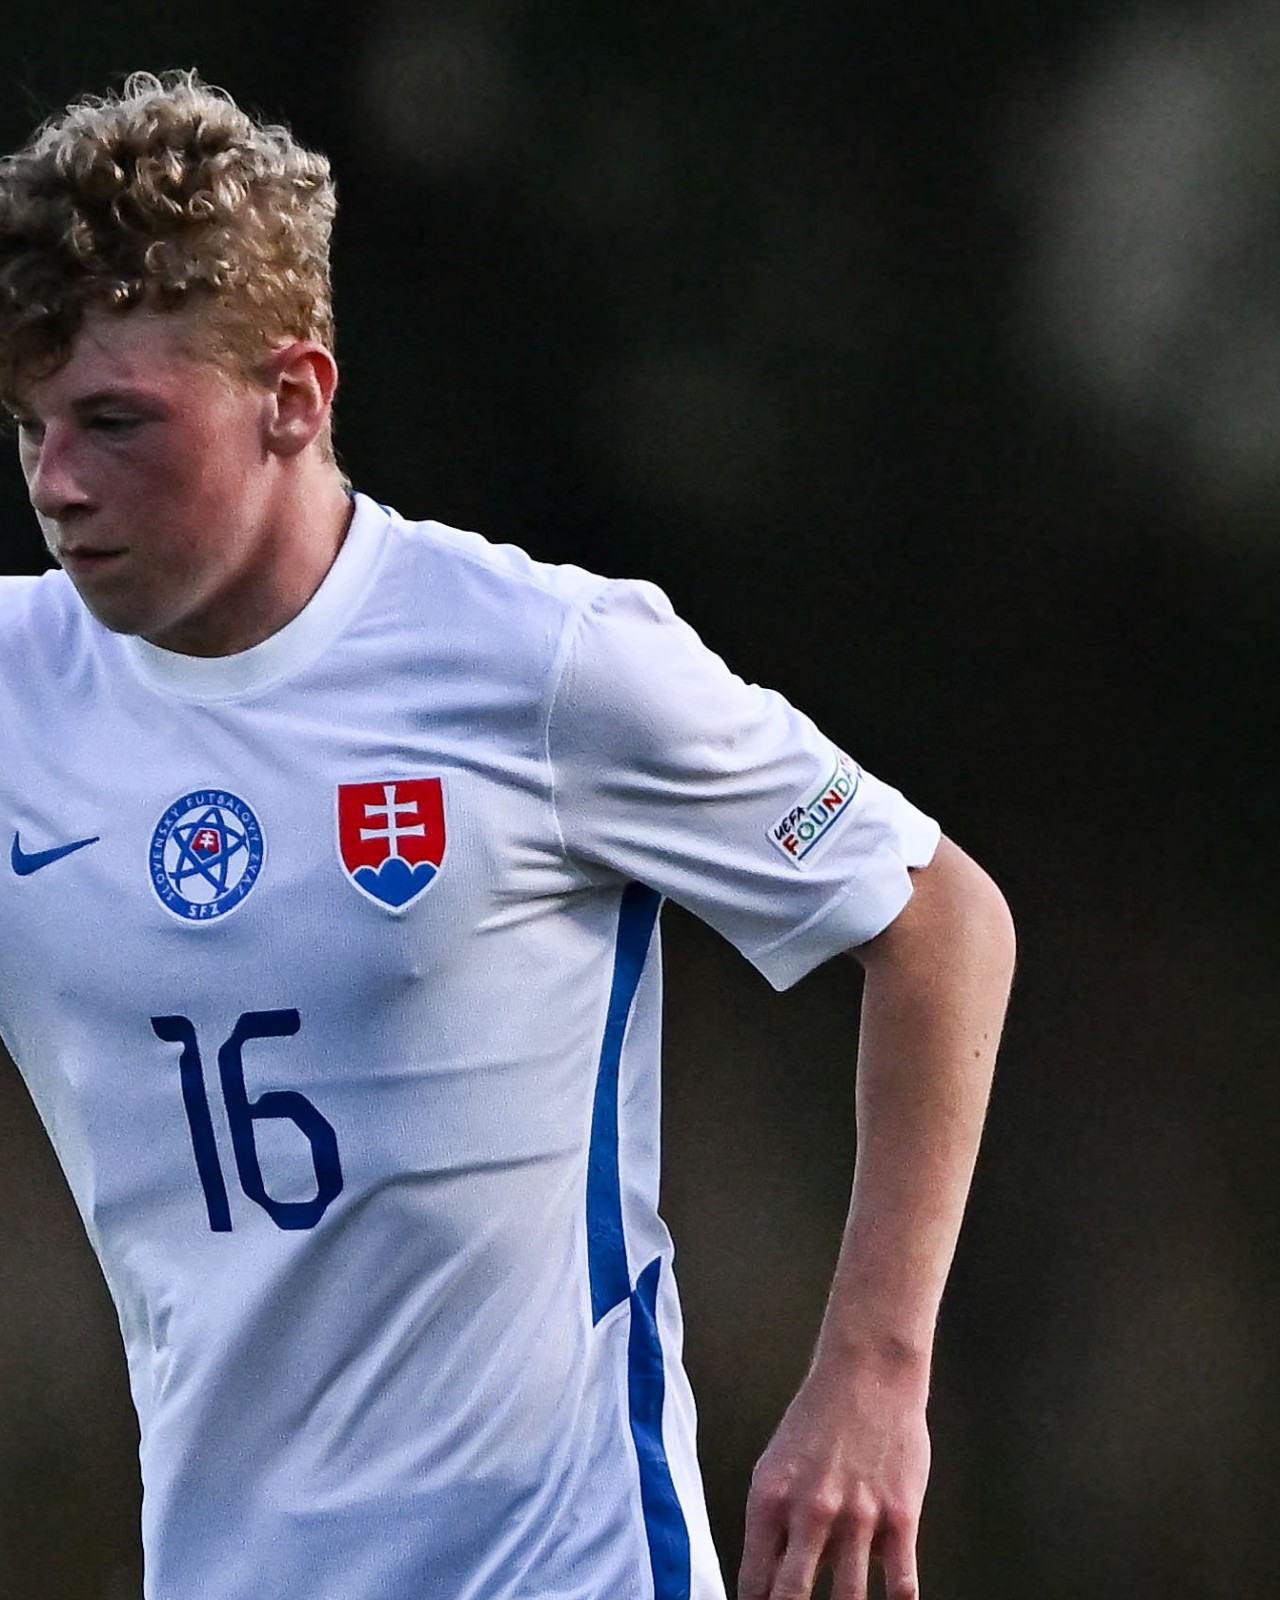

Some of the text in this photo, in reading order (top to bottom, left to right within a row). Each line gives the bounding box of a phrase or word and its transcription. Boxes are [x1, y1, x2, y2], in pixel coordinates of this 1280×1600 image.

[774, 806, 806, 840] UEFA
[188, 904, 220, 917] SFZ
[150, 1008, 344, 1232] 16
